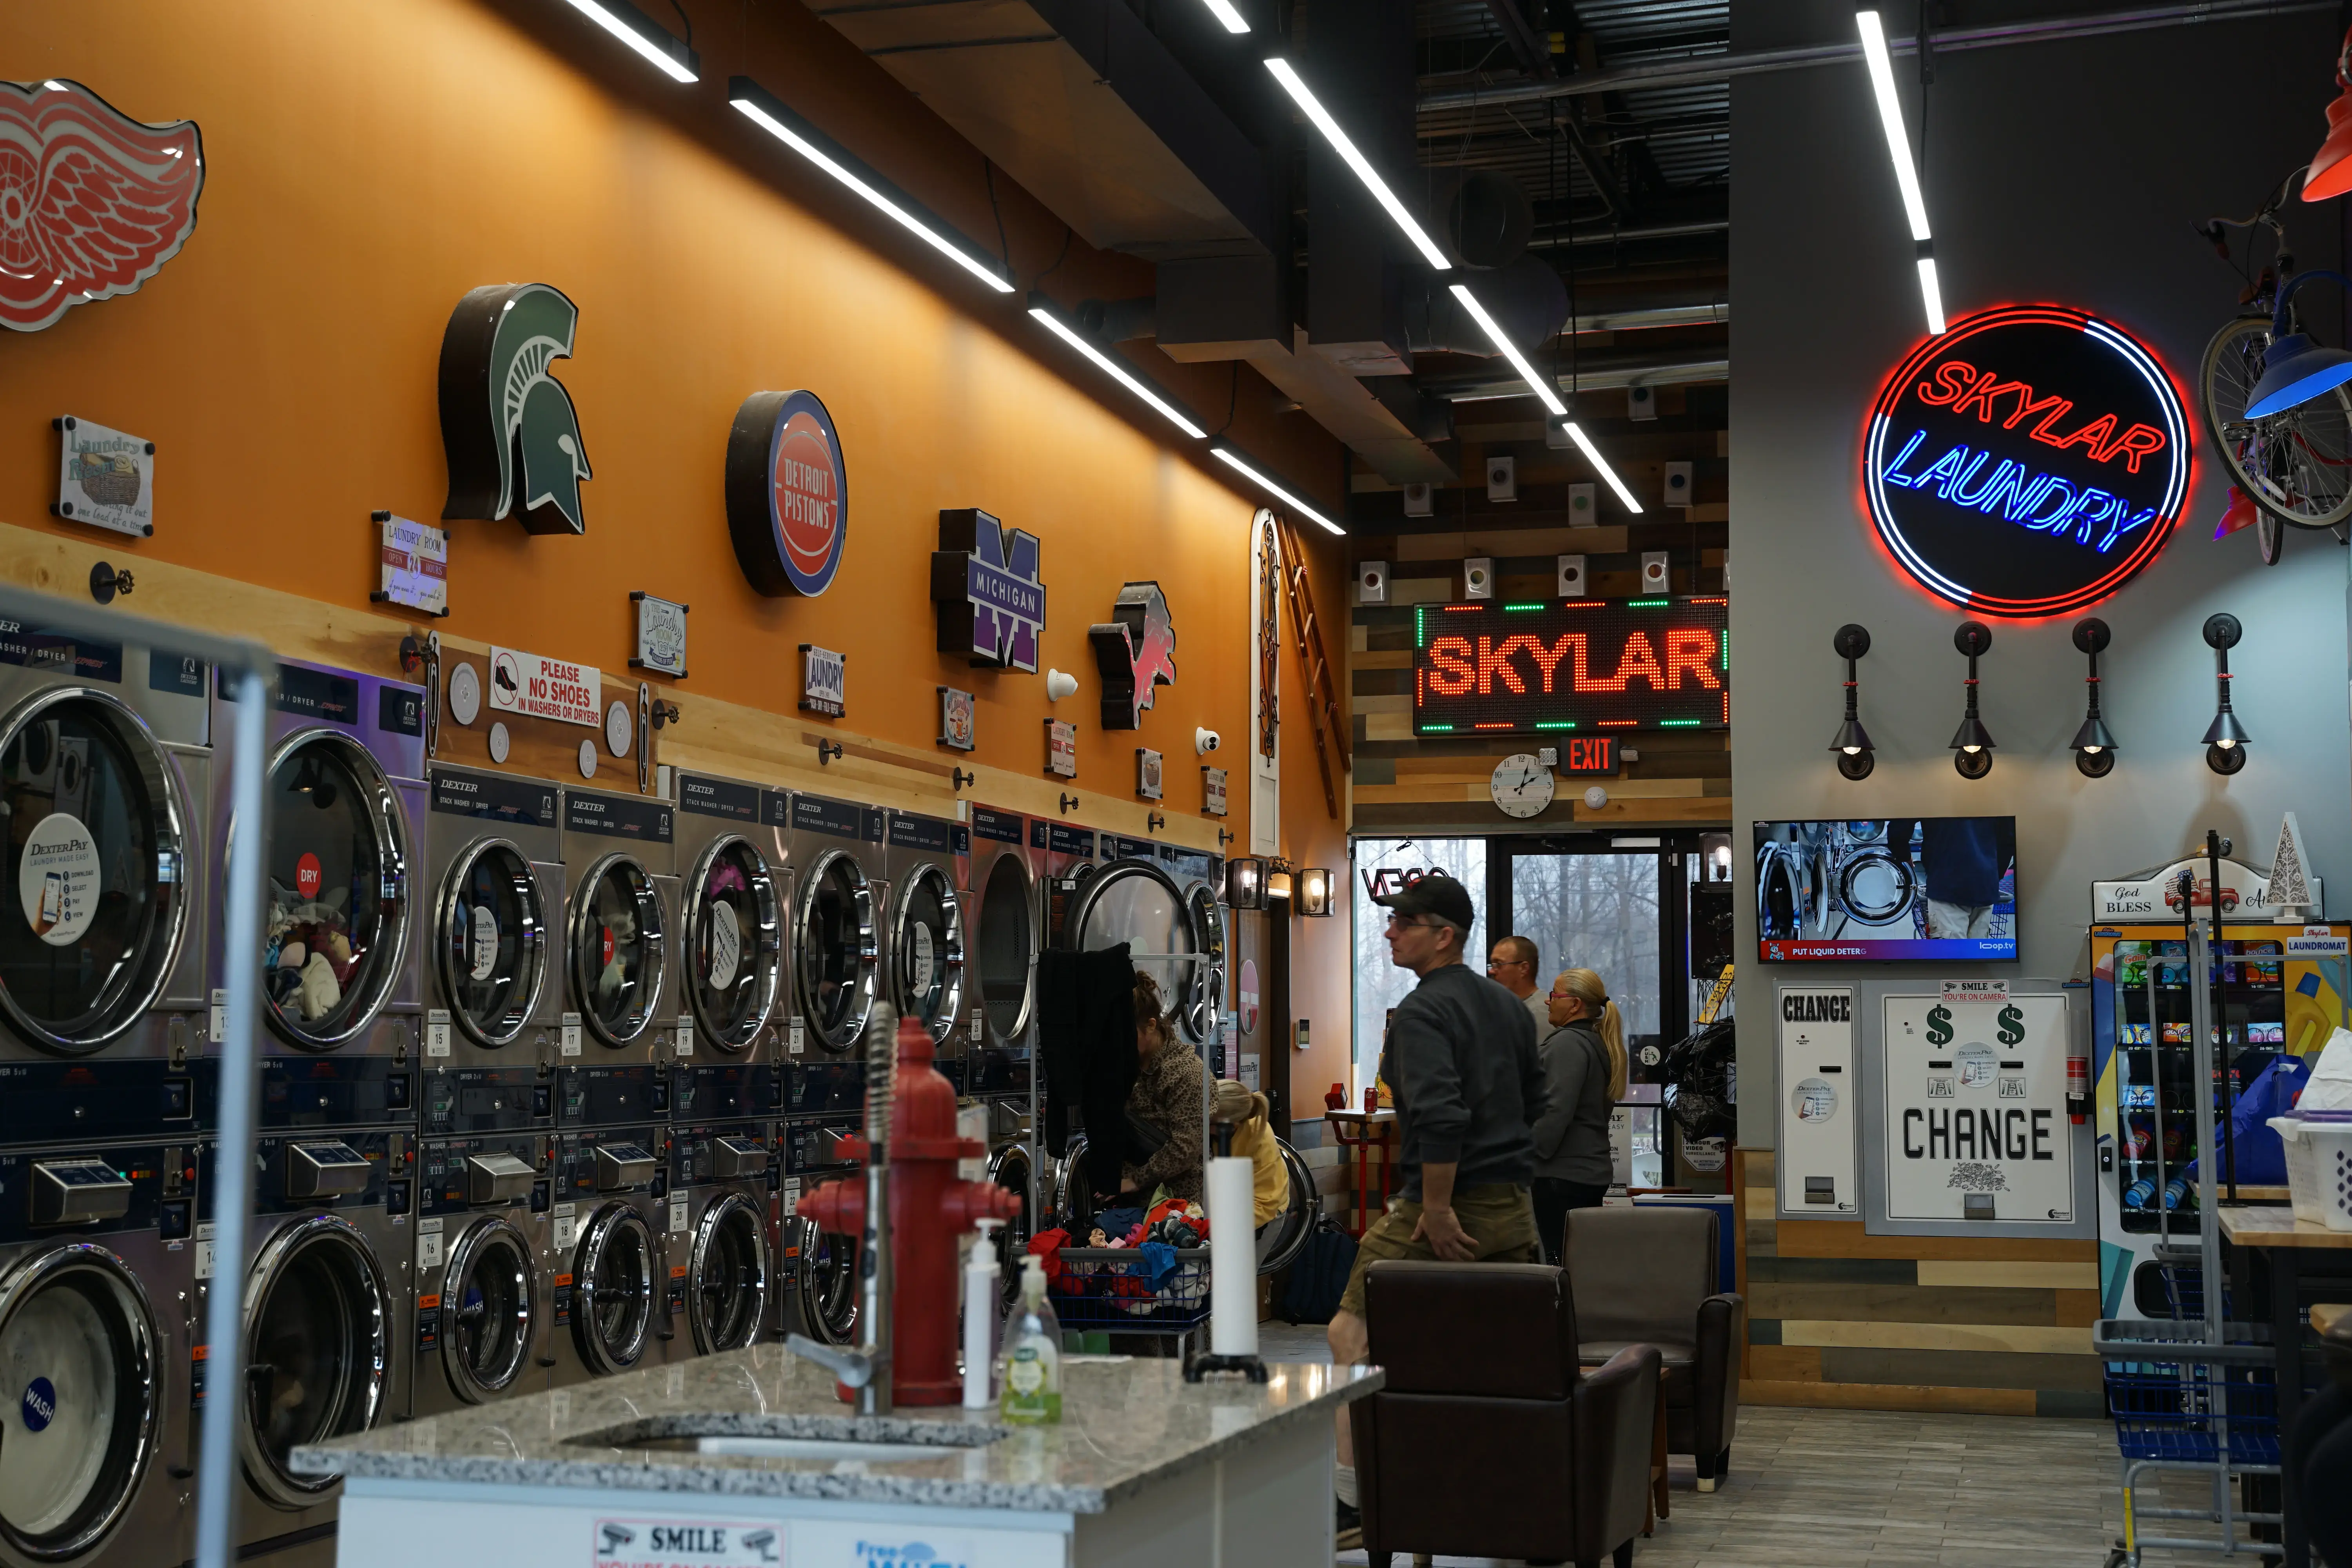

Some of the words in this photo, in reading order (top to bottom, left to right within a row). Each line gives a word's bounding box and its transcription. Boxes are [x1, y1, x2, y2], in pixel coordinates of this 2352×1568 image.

[1918, 361, 2165, 474] SKYLAR
[70, 430, 140, 454] Laundry
[785, 458, 828, 497] DETROIT
[1882, 430, 2156, 553] LAUNDRY
[135, 509, 148, 518] out
[784, 489, 829, 529] PISTONS
[78, 508, 90, 517] one
[93, 508, 111, 523] load
[113, 517, 122, 526] at
[389, 526, 421, 545] LAUNDRY
[425, 536, 441, 552] ROOM
[389, 552, 403, 564] OPEN
[410, 557, 418, 573] 24
[426, 563, 442, 575] HOURS
[976, 572, 1035, 612] MICHIGAN
[651, 604, 661, 613] THE
[644, 604, 682, 646] Laundry
[656, 628, 672, 642] ROOM
[38, 650, 66, 662] DRYER
[653, 654, 662, 664] LOADS
[1429, 631, 1720, 695] SKYLAR
[541, 661, 579, 683] PLEASE
[807, 656, 844, 698] LAUNDRY
[530, 677, 547, 699] NO
[551, 681, 590, 707] SHOES
[293, 696, 314, 706] DRYER
[518, 697, 526, 711] IN
[528, 699, 561, 718] WASHERS
[563, 704, 572, 719] OR
[574, 705, 599, 724] DRYERS
[1062, 744, 1065, 753] 24
[1570, 739, 1611, 769] EXIT
[441, 779, 478, 792] DEXTER
[687, 784, 714, 795] DEXTER
[454, 799, 470, 807] WASHER
[476, 802, 488, 810] DRYER
[573, 801, 605, 812] DEXTER
[701, 800, 717, 809] WASHER
[798, 802, 821, 813] DEXTER
[810, 818, 824, 826] WASHER
[978, 814, 995, 823] DEXTER
[894, 821, 915, 830] DEXTER
[30, 857, 56, 866] LAUNDRY
[58, 855, 74, 863] MADE
[75, 853, 89, 861] EASY
[71, 870, 94, 878] DOWNLOAD
[300, 869, 318, 883] DRY
[2115, 887, 2140, 900] God
[2106, 902, 2151, 913] BLESS
[2307, 929, 2328, 938] Skylar
[1809, 948, 1835, 956] LIQUID
[1979, 942, 2013, 951] loop.tv
[2124, 953, 2146, 964] Gain
[1783, 995, 1851, 1023] CHANGE
[975, 1024, 978, 1033] 25
[436, 1033, 443, 1044] 15
[568, 1034, 574, 1044] 17
[682, 1036, 688, 1045] 19
[794, 1035, 799, 1044] 21
[1903, 1107, 2053, 1160] CHANGE
[789, 1196, 795, 1205] 22
[676, 1211, 682, 1221] 20
[561, 1226, 568, 1236] 18
[427, 1242, 434, 1254] 16
[25, 1387, 54, 1422] WASH
[650, 1527, 727, 1553] SMILE
